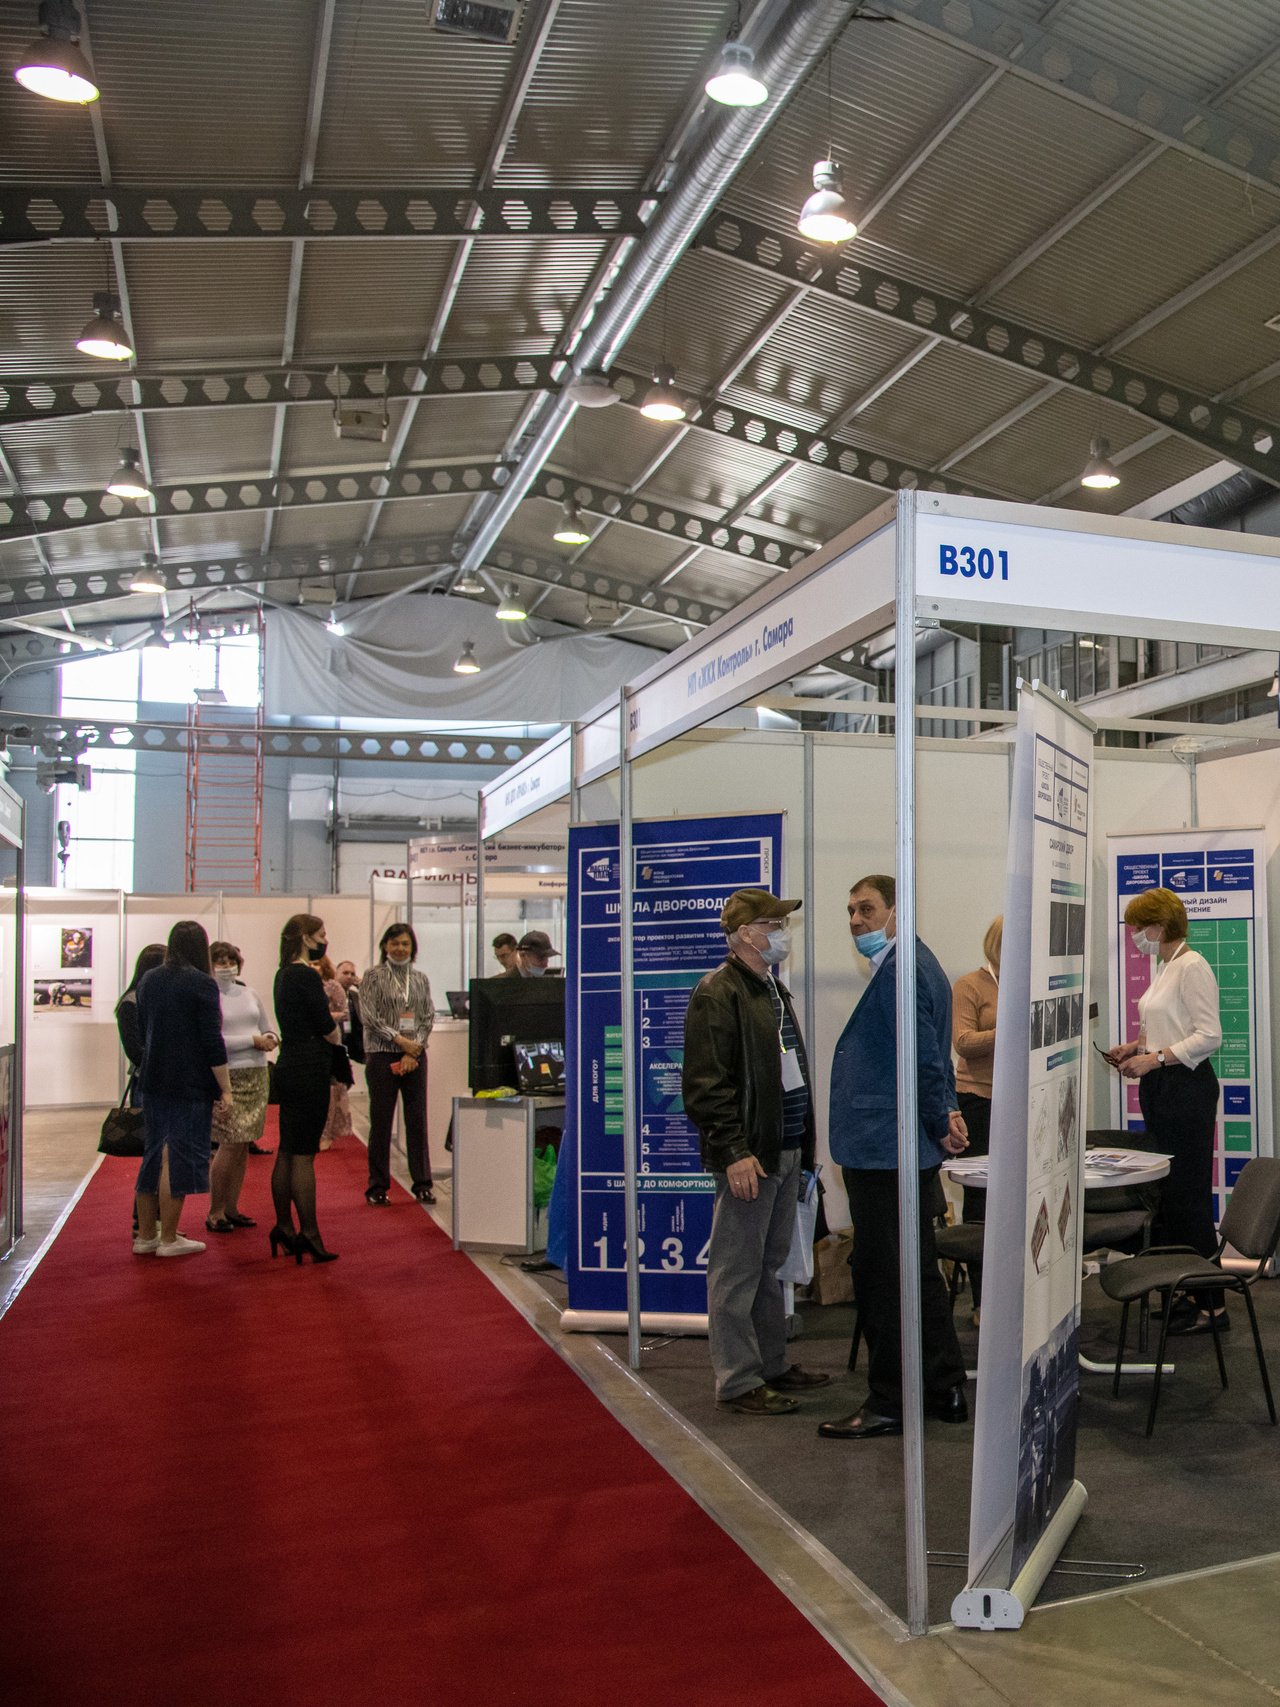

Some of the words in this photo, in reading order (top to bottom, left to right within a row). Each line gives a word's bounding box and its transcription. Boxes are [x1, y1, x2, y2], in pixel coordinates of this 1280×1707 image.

[763, 617, 794, 652] Самара
[498, 843, 565, 851] бизнес-инкубатор»
[472, 853, 498, 862] Сара
[605, 901, 651, 915] ШКЛА
[643, 999, 649, 1009] 1
[642, 1017, 650, 1028] 2
[642, 1037, 650, 1048] 3
[642, 1124, 650, 1135] 4
[642, 1144, 650, 1154] 5
[642, 1162, 650, 1173] 6
[614, 1180, 642, 1188] ШАВ
[644, 1180, 656, 1188] ДО
[658, 1179, 716, 1188] КОМФОРТНОЙ
[594, 1236, 607, 1270] 1
[661, 1237, 684, 1271] 3
